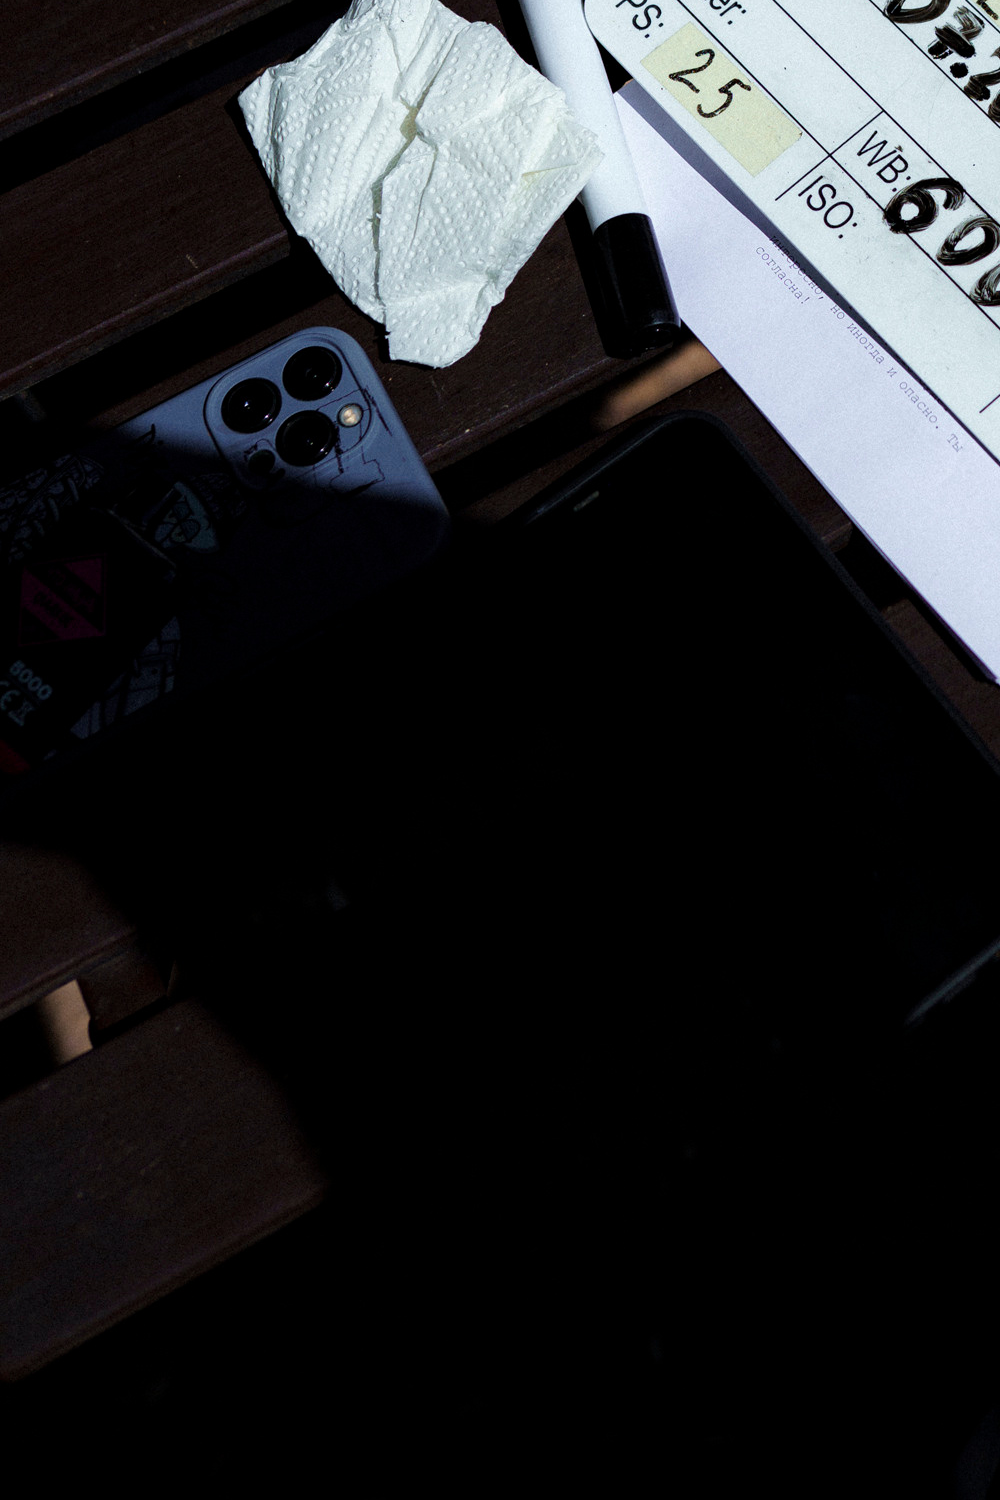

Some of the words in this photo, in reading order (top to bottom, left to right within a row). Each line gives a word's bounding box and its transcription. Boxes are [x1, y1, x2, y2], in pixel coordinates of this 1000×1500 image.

[668, 47, 751, 119] 25
[856, 130, 912, 192] WB:
[797, 174, 858, 240] ISO:
[755, 246, 810, 305] согласна!
[830, 304, 846, 320] но
[846, 323, 885, 365] иногда
[886, 367, 898, 378] и
[899, 380, 939, 430] опасно.
